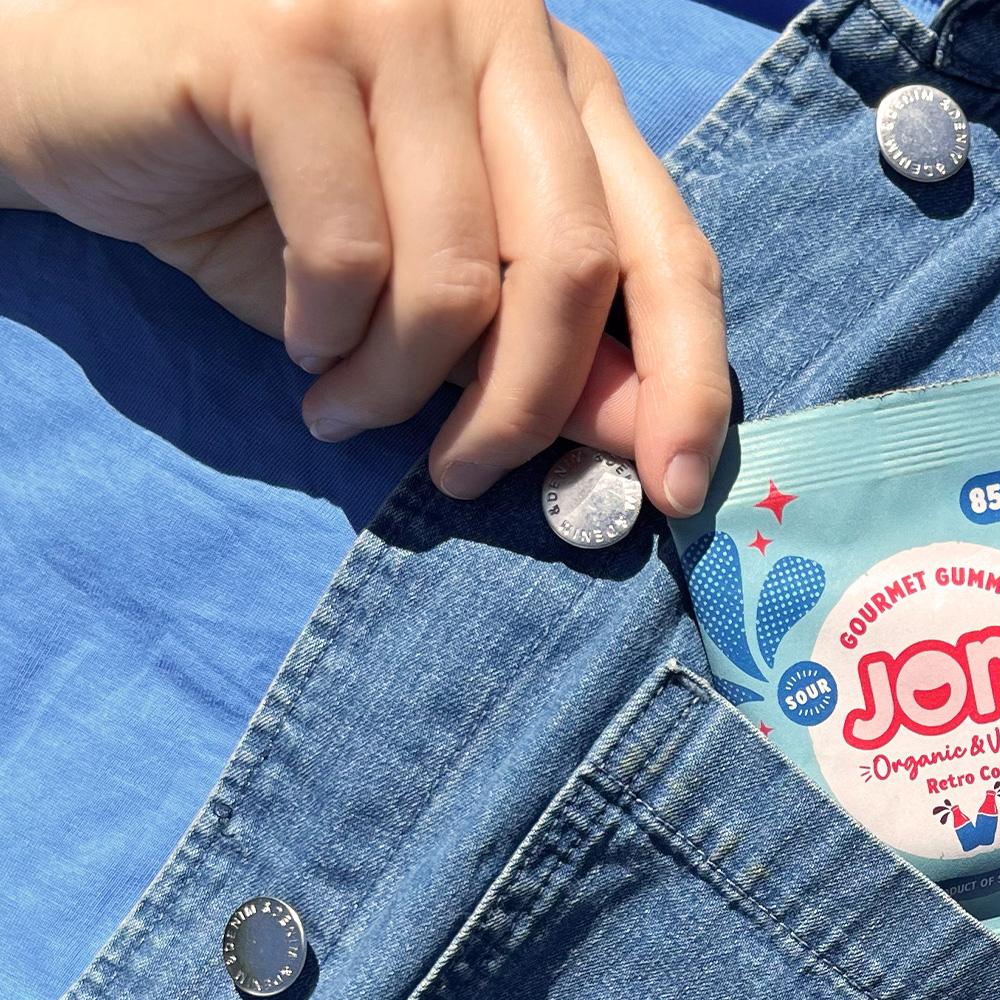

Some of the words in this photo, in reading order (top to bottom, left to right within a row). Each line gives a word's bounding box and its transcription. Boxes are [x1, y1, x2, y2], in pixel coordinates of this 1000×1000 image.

[839, 571, 926, 650] GOURMET
[784, 677, 832, 711] SOUR
[873, 744, 967, 781] Organic
[970, 735, 985, 757] &
[926, 774, 975, 794] Retro
[980, 876, 993, 888] OF
